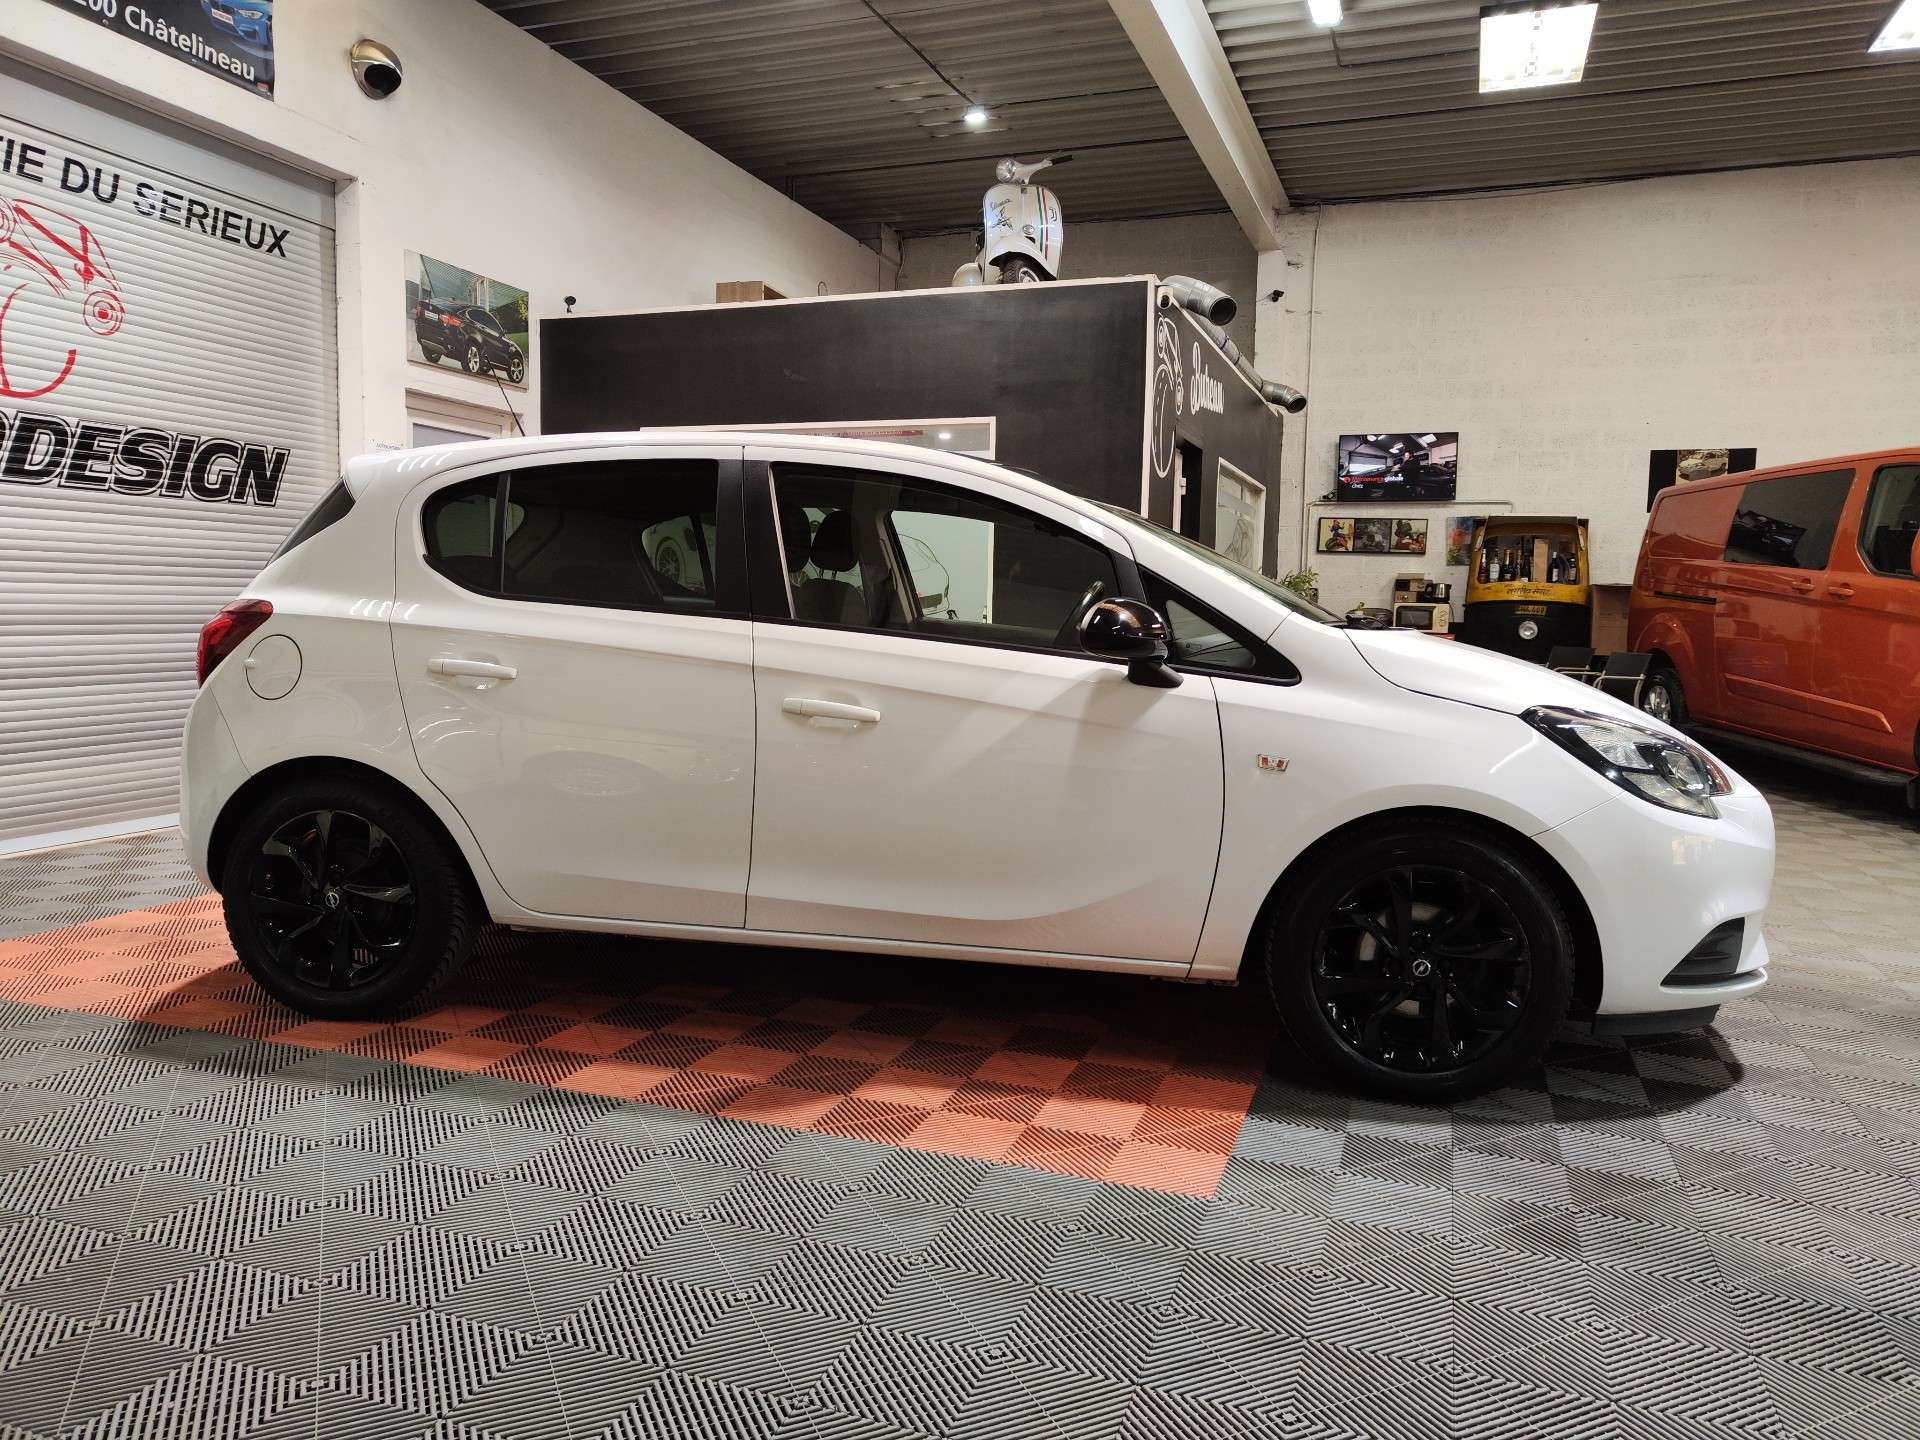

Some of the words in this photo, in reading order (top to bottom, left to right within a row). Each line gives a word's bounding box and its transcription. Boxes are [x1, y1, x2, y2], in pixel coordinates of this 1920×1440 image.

[125, 5, 255, 82] Châtelineau
[0, 135, 46, 183] IE
[60, 157, 121, 204] DU
[133, 183, 291, 258] SERIEUX
